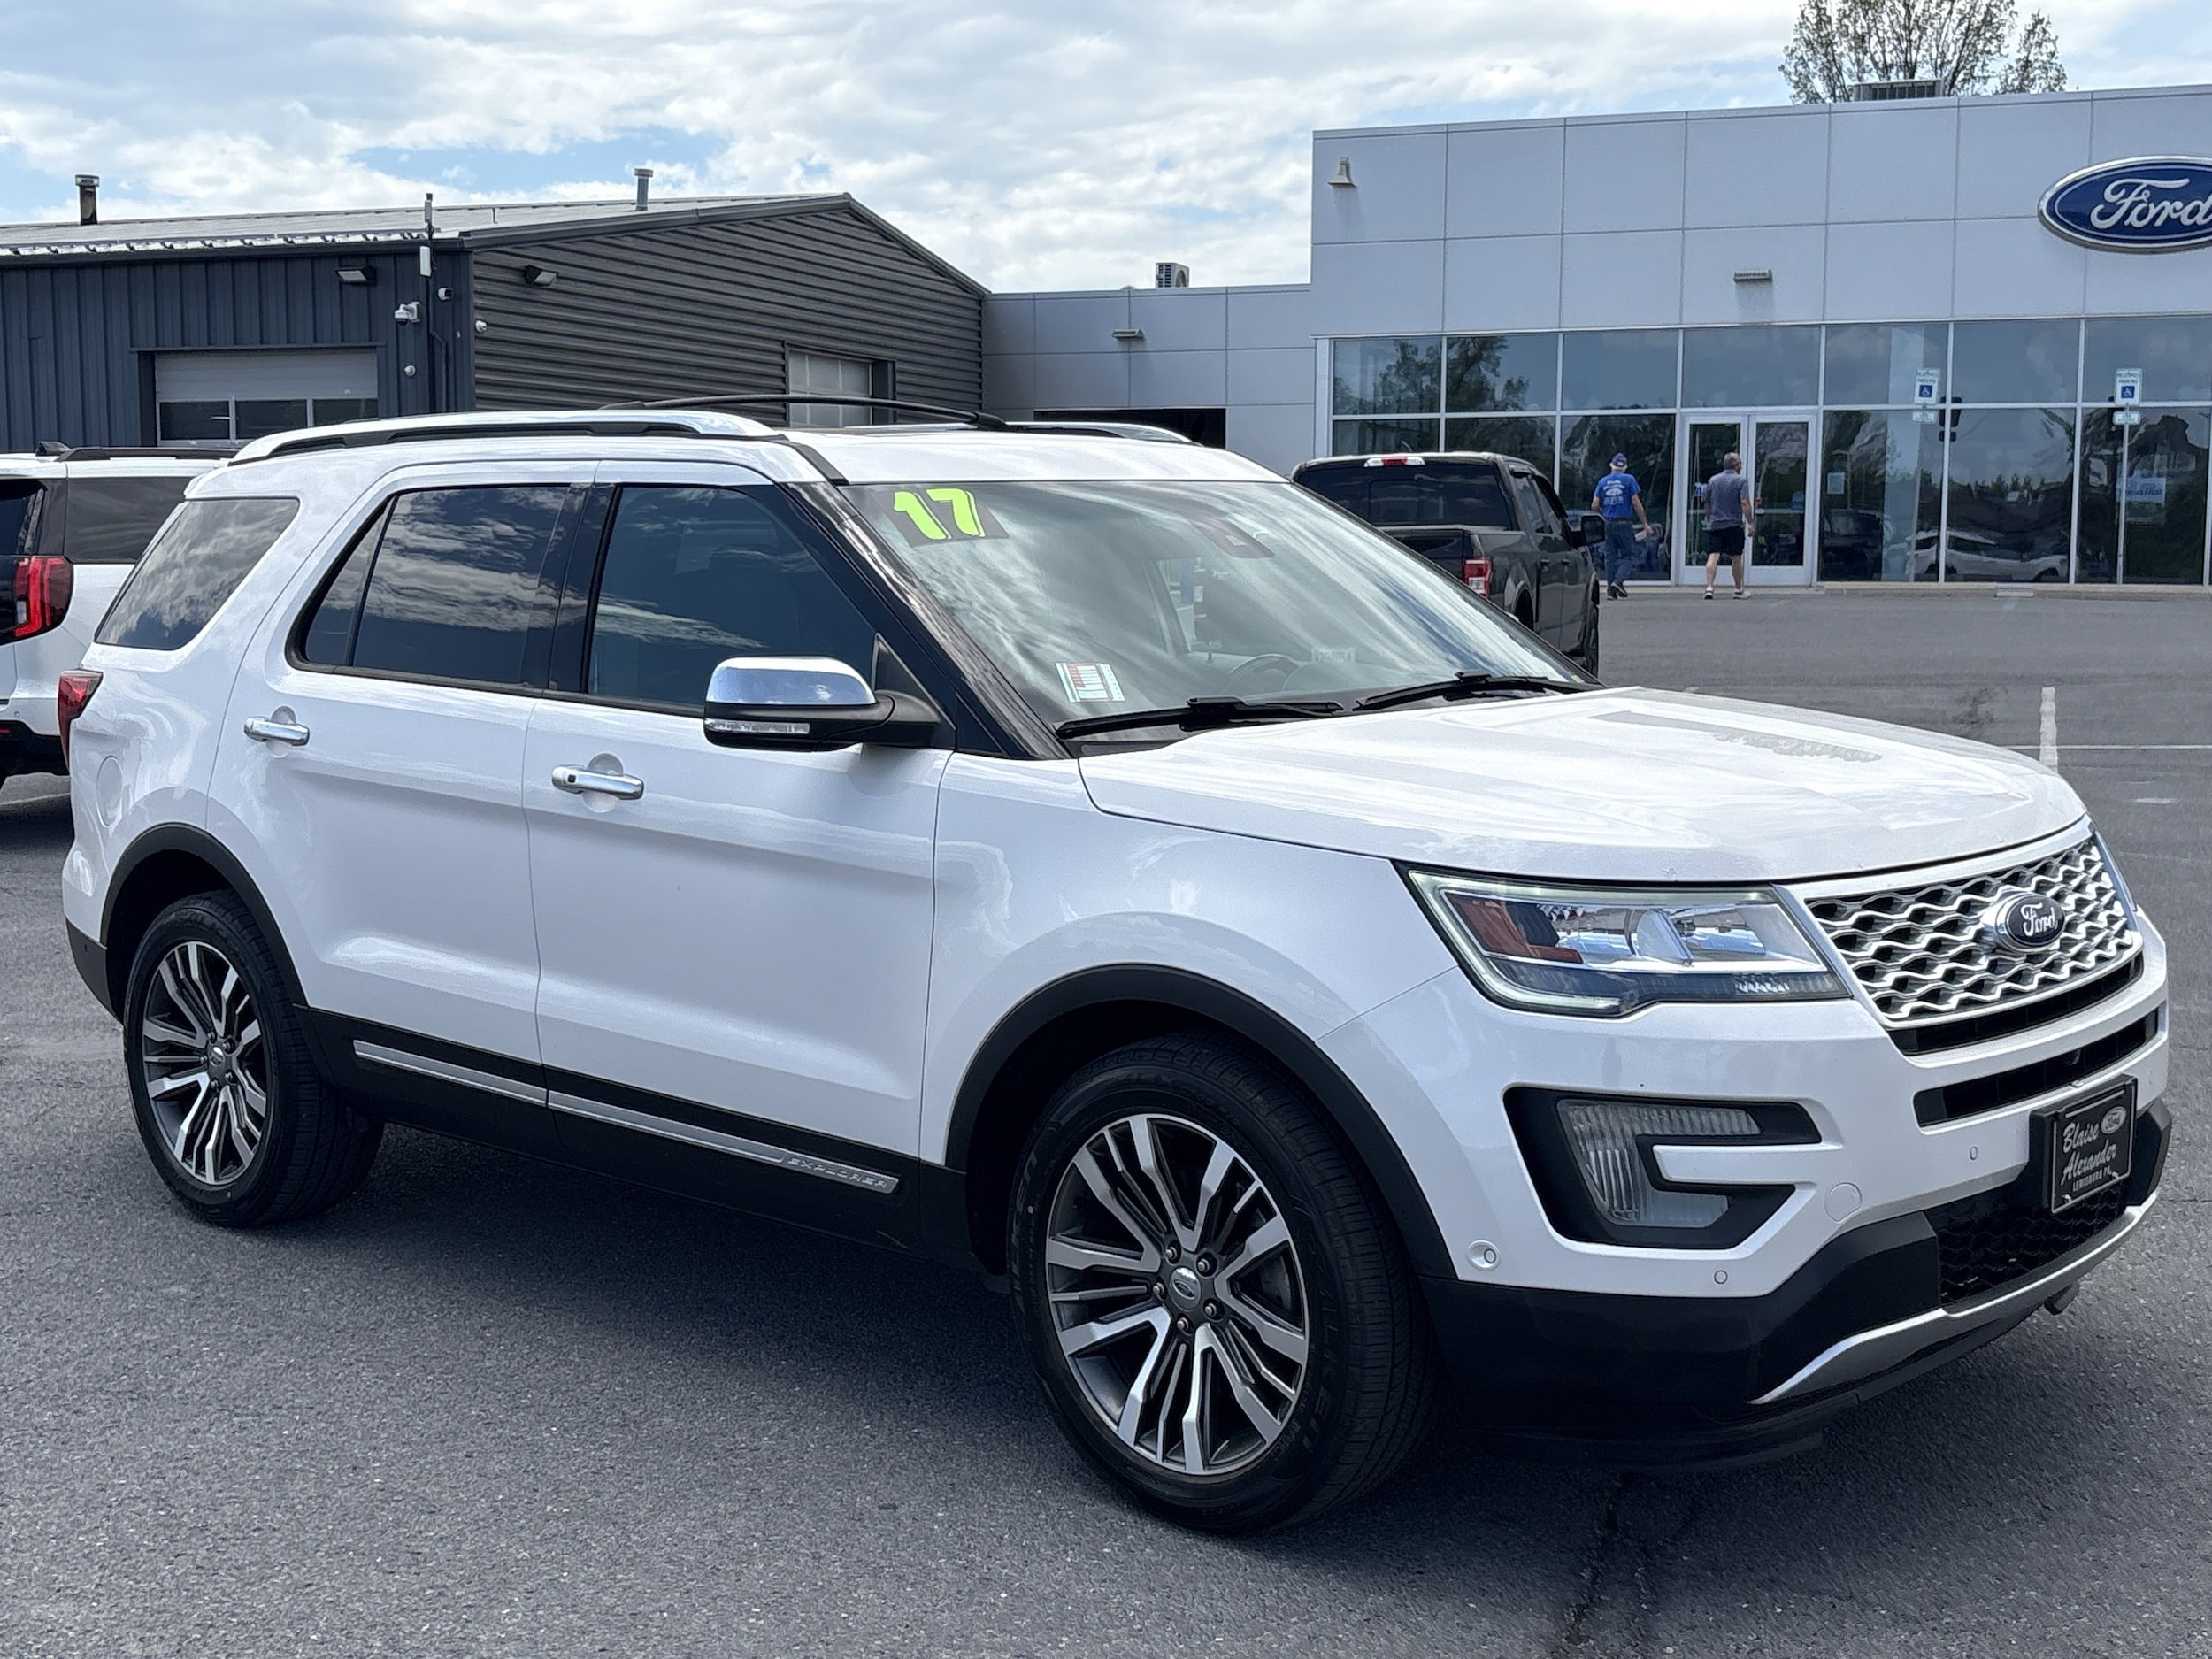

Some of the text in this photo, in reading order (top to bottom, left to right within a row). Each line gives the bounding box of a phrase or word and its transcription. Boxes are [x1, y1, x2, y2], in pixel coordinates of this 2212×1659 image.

[2090, 178, 2212, 230] Ford
[893, 488, 986, 540] 17
[2020, 902, 2059, 937] Ford
[2060, 1138, 2117, 1187] Alexander
[2062, 1122, 2100, 1154] Blaise
